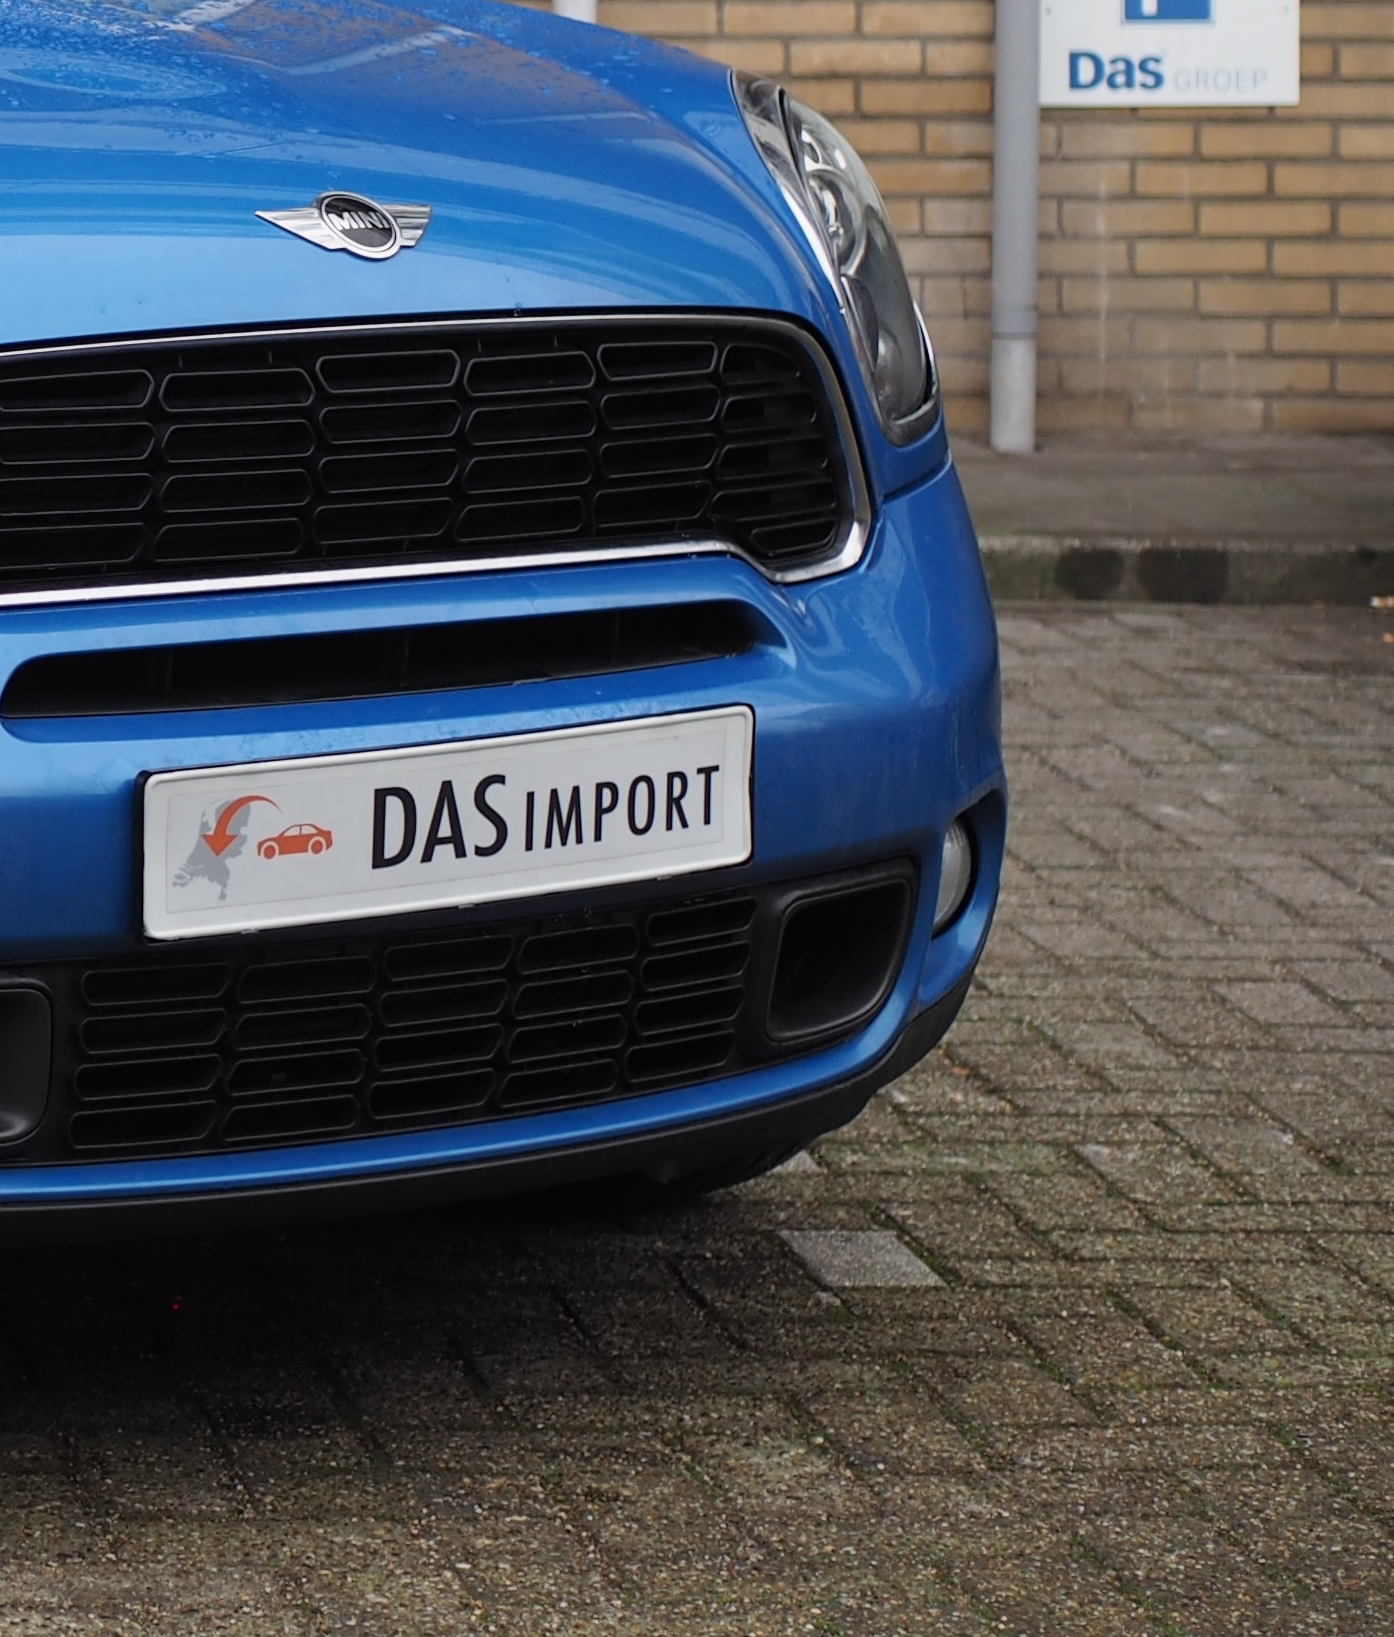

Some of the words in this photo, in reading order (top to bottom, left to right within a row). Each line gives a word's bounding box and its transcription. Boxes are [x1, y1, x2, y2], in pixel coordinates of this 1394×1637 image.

[1068, 50, 1165, 92] Das
[1174, 67, 1269, 92] GROEP
[327, 210, 391, 231] MINI
[371, 774, 508, 870] DAS
[523, 765, 721, 852] IMPORT
